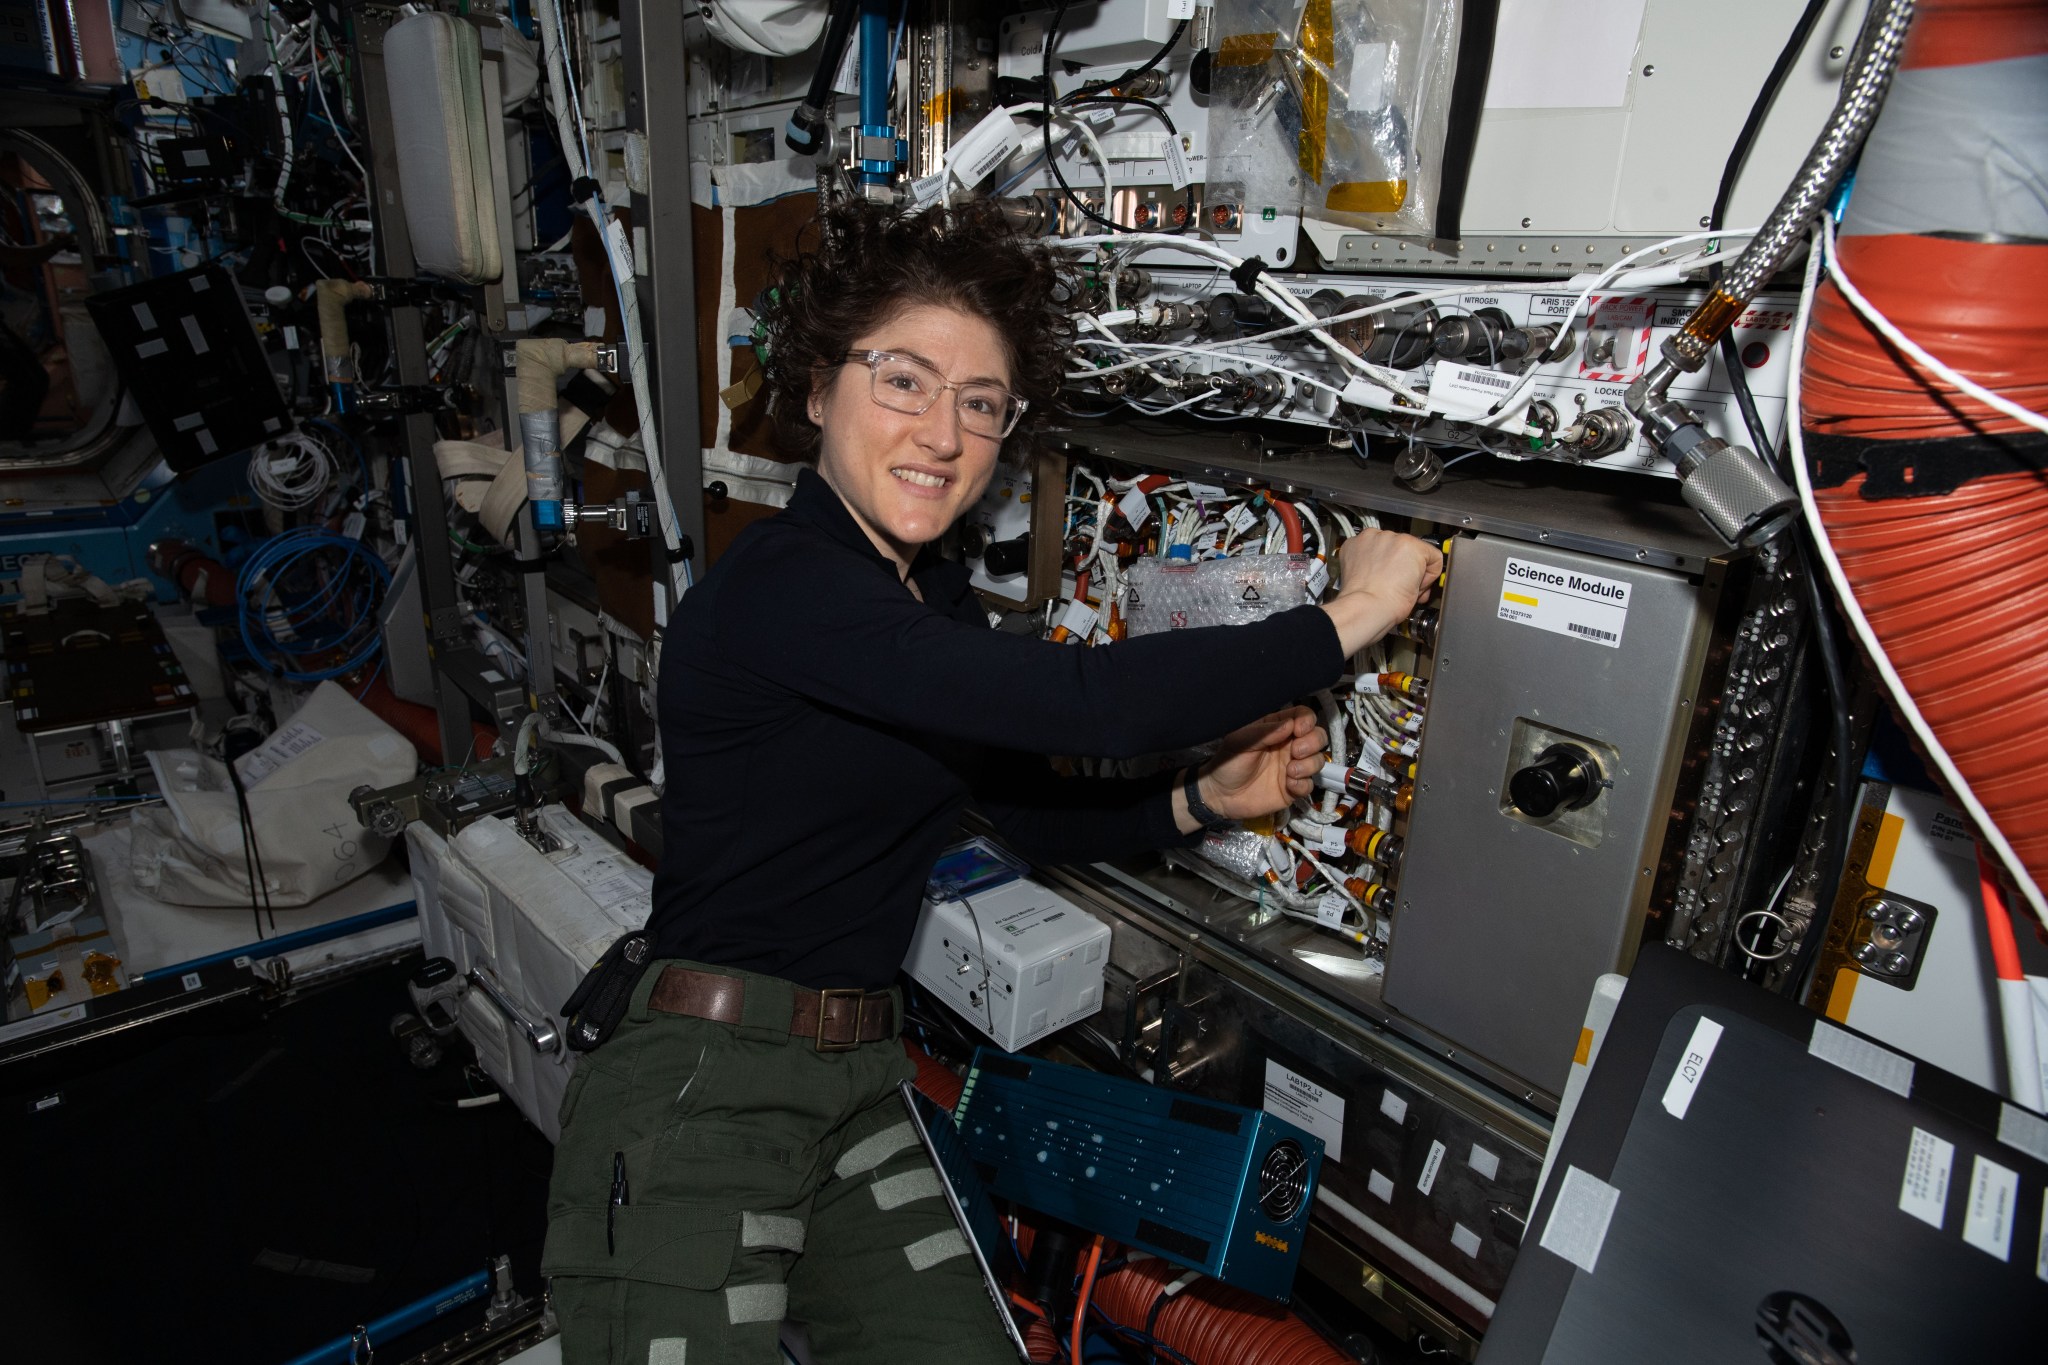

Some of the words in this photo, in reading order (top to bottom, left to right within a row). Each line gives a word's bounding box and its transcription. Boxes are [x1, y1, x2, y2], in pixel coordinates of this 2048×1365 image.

[1022, 44, 1038, 56] Cold
[1595, 387, 1624, 397] LOCKE
[1447, 431, 1460, 439] G2
[1642, 458, 1654, 468] J2
[1508, 563, 1564, 586] Science
[1568, 576, 1625, 600] Module
[322, 822, 357, 881] 064
[1682, 1052, 1703, 1083] ELC7
[1286, 1073, 1323, 1097] LAB1P2_L2
[1428, 1155, 1438, 1173] Molecular
